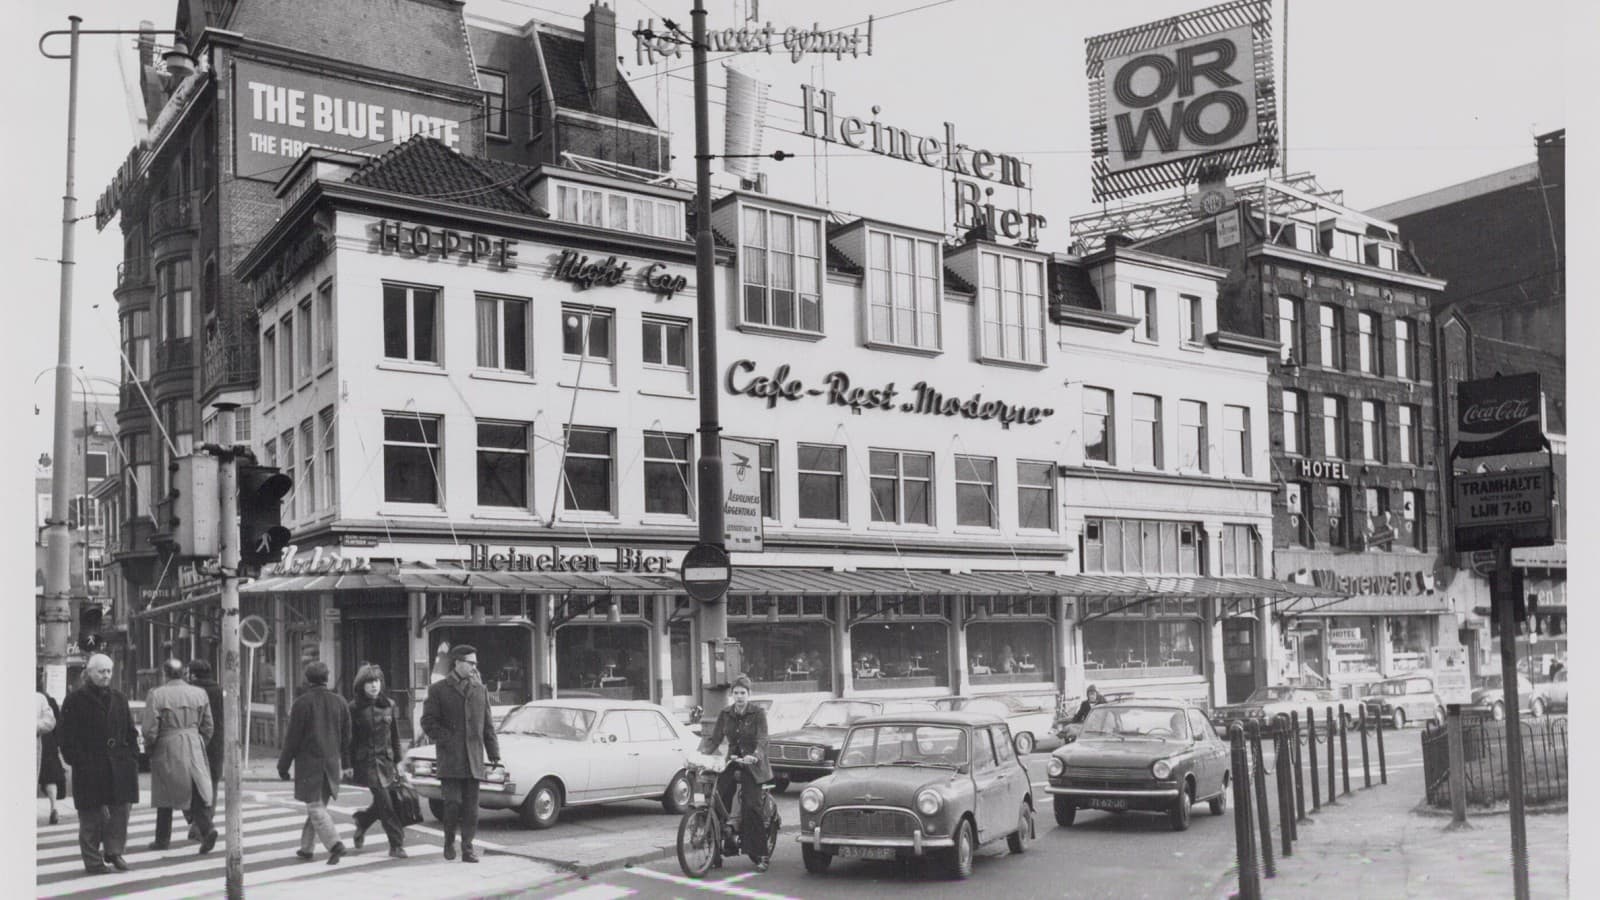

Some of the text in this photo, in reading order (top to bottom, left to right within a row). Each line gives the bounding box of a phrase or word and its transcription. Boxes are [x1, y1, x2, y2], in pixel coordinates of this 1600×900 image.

[249, 82, 460, 154] THE BLUE NOTE
[249, 132, 276, 154] THE
[281, 138, 320, 158] FIRS
[801, 84, 1025, 188] Heineken
[952, 178, 1048, 243] Bier
[380, 219, 518, 268] HOPPE
[553, 249, 688, 300] Night Cap
[1302, 459, 1350, 480] HOTEL
[1461, 475, 1541, 496] TRAMHALTE
[1470, 500, 1532, 518] LIJN 7-10
[470, 543, 673, 573] Heineken Bier
[1312, 569, 1412, 596] Wienerwald
